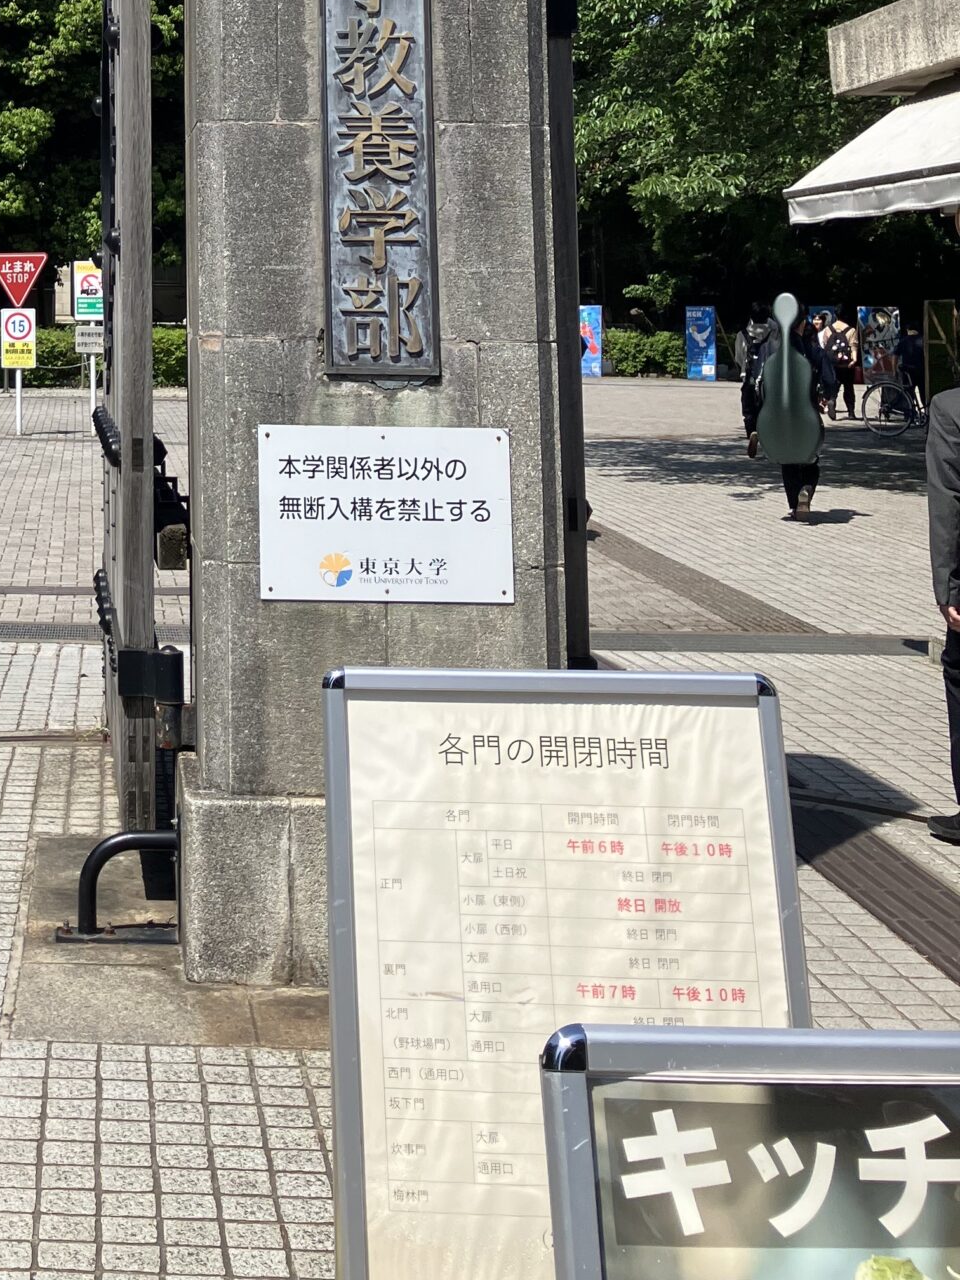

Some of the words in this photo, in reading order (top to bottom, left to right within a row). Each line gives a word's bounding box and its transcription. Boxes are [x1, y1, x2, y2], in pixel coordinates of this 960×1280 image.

[1, 261, 35, 272] 止まれ
[7, 274, 29, 283] STOP
[11, 320, 25, 333] 15
[279, 455, 467, 481] 本学関係者以外の
[279, 496, 491, 522] 無断入構を禁止する
[359, 557, 447, 576] 東京大学
[424, 577, 448, 585] TOKYO
[438, 733, 669, 769] 各門の開閉時間
[446, 809, 470, 822] 各門
[568, 812, 619, 827] 開門時間
[668, 814, 719, 828] 閉門時間
[491, 839, 512, 850] 平日
[567, 839, 624, 855] 午前6時
[661, 842, 732, 858] 午後10時
[461, 852, 483, 864] 大扉
[493, 867, 527, 879] 土日祝
[622, 871, 644, 883] 終日
[652, 872, 672, 883] 閉門
[380, 878, 402, 890] 正門
[618, 898, 646, 913] 終日
[655, 899, 682, 913] 開放
[627, 928, 648, 940] 終日
[655, 929, 677, 940] 閉門
[467, 952, 489, 963] 大扉
[629, 957, 650, 969] 終日
[658, 958, 679, 970] 閉門
[384, 964, 406, 976] 裏門
[467, 981, 502, 993] 通用口
[576, 983, 636, 1000] 午前7時
[673, 986, 745, 1003] 午後10時
[385, 1008, 408, 1020] 北門
[469, 1011, 492, 1023] 大扉
[394, 1038, 451, 1051] （野球場門）
[471, 1040, 505, 1053] 通用口
[388, 1067, 464, 1081] 西門（通用口）
[389, 1098, 425, 1110] 坂下門
[476, 1132, 499, 1144] 大扉
[391, 1144, 426, 1155] 炊事門
[478, 1162, 514, 1175] 通用口
[393, 1189, 428, 1202] 梅林門
